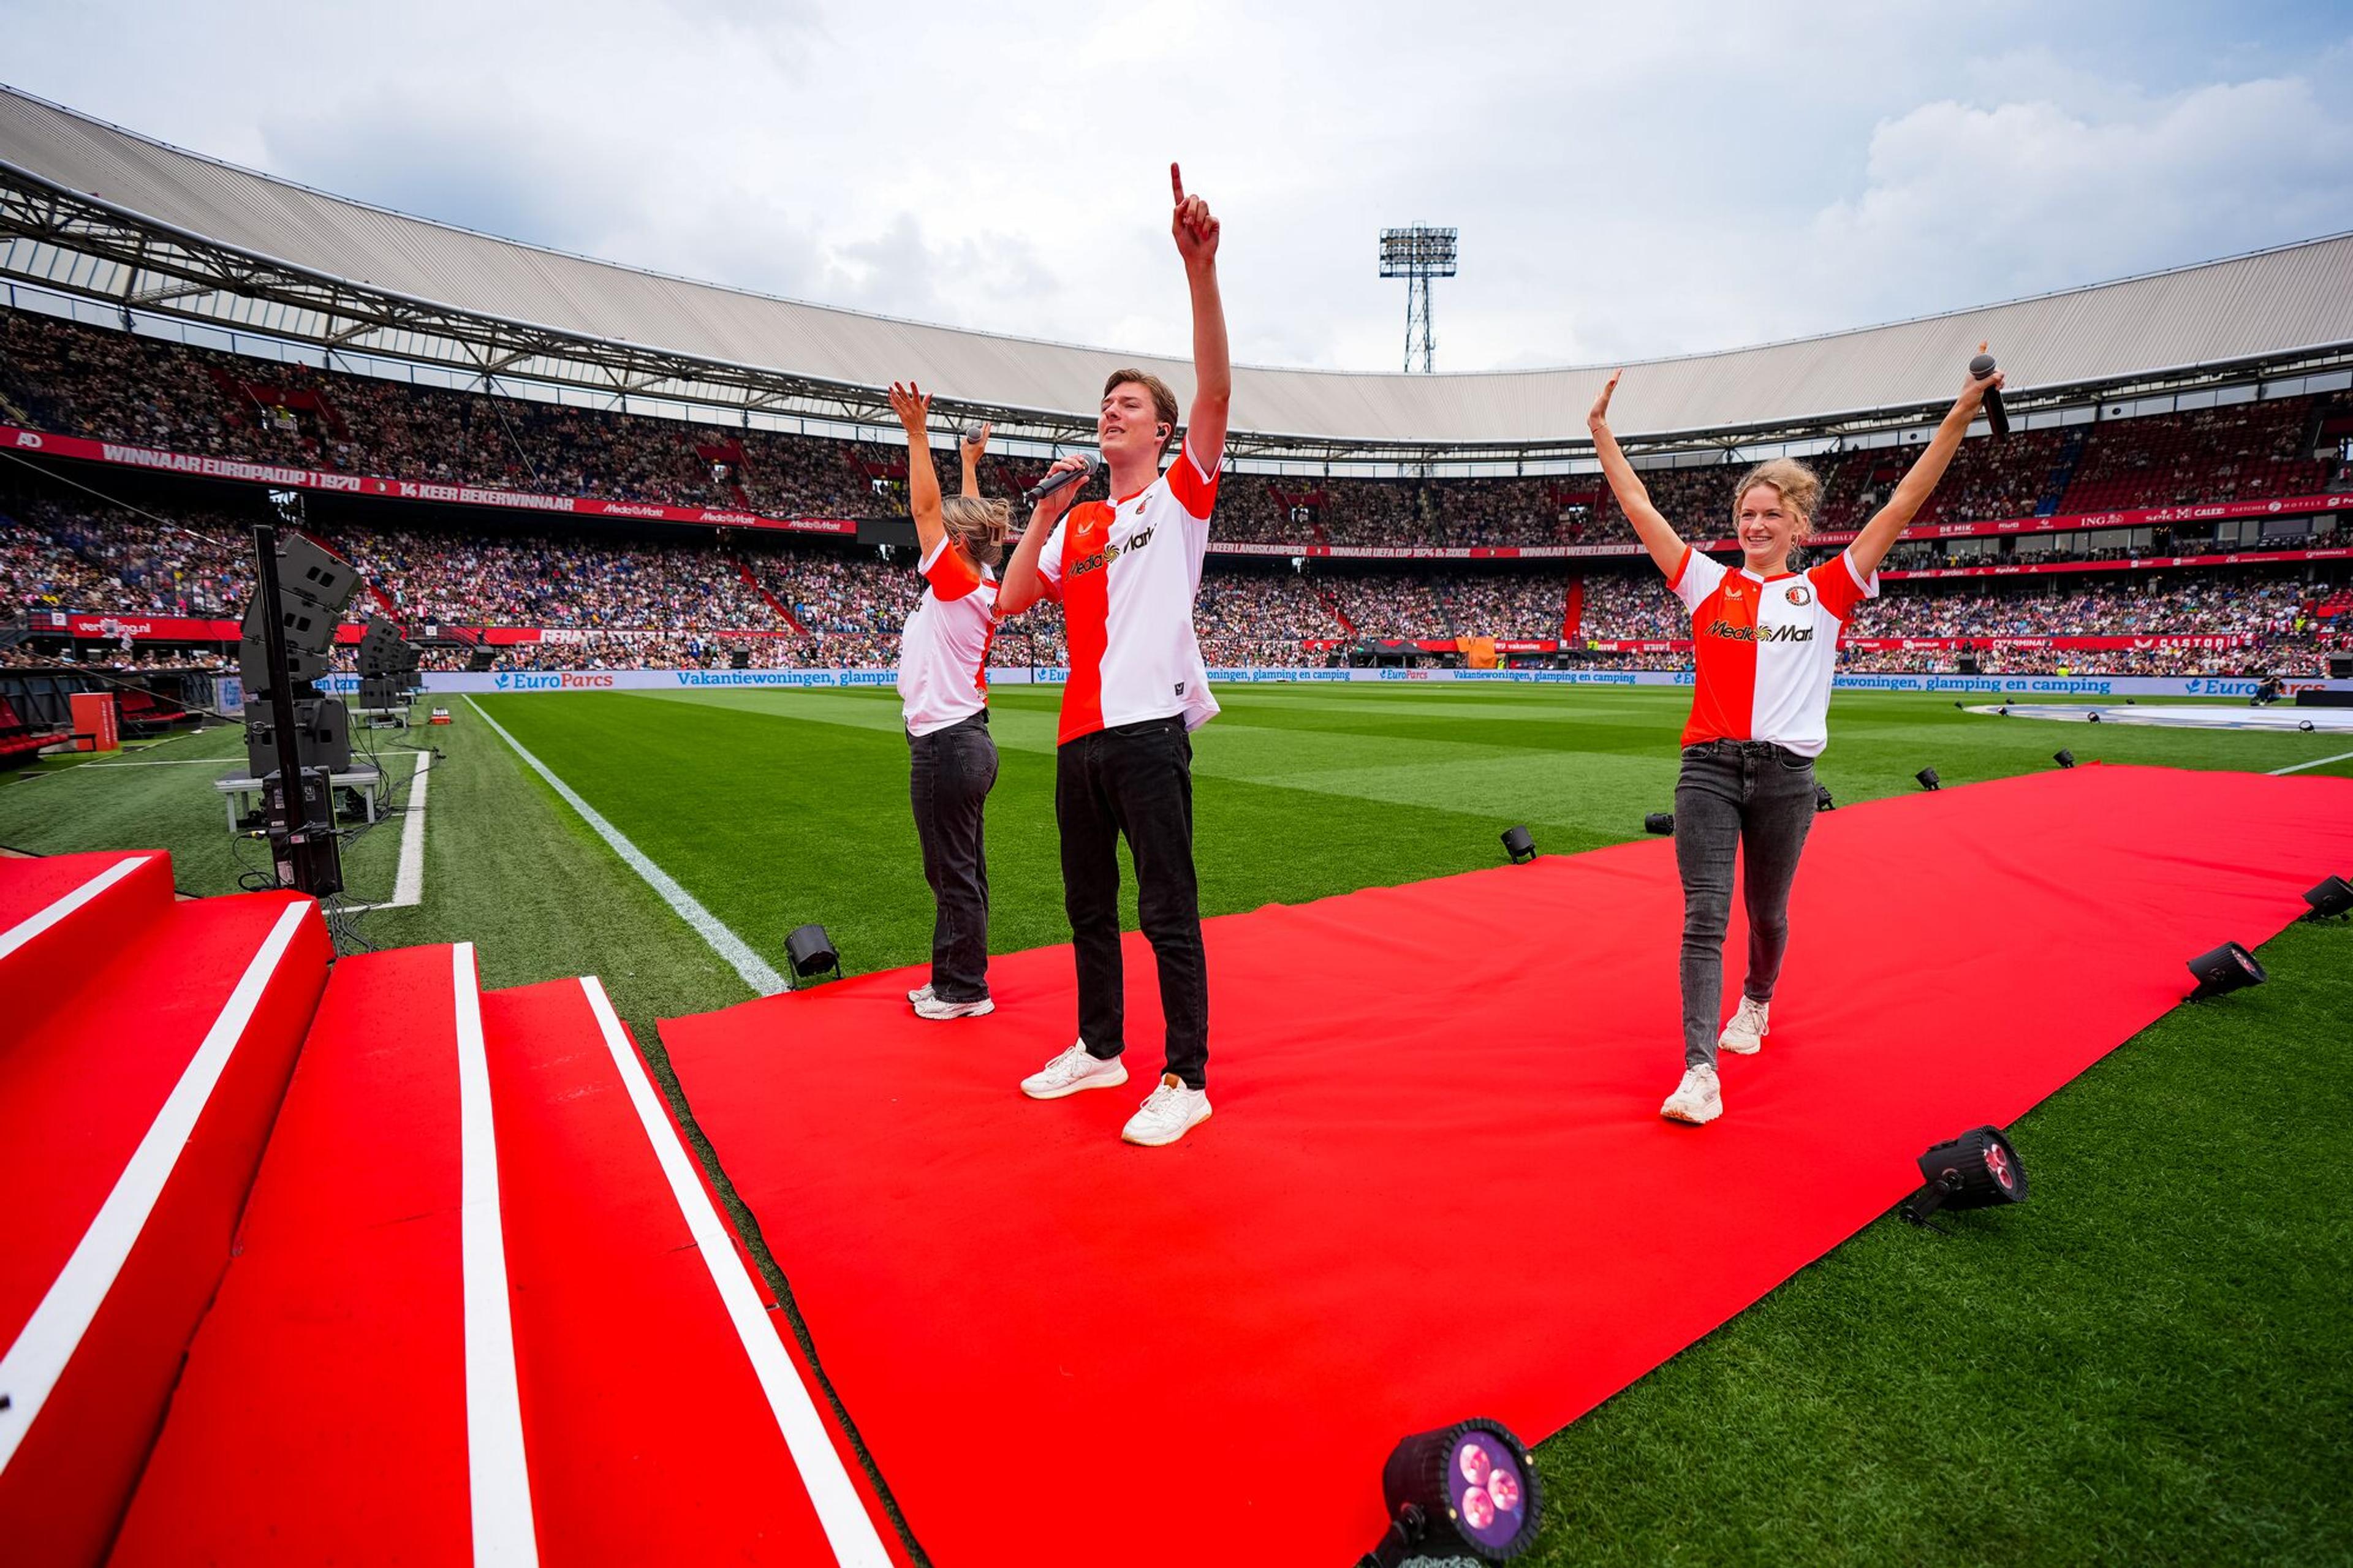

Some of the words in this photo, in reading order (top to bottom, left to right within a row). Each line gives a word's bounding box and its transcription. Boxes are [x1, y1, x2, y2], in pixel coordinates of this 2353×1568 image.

[17, 432, 42, 448] AD
[102, 443, 200, 471] WINNAAR
[203, 459, 306, 484] EUROPACUP
[308, 472, 316, 485] 1
[320, 474, 360, 491] 1970
[399, 482, 417, 498] 14
[419, 483, 458, 501] KEER
[459, 488, 574, 511] BEKERWINNAAR
[2081, 516, 2106, 526] ING
[1213, 543, 1234, 553] KEER
[1234, 543, 1306, 555] LANDSKAMPIOEN
[1330, 547, 1373, 557] WINNAAR
[1374, 547, 1394, 557] UEFA
[1395, 548, 1412, 557] CUP
[1446, 548, 1470, 557] 2002
[1520, 547, 1564, 557] WINNAAR
[1566, 545, 1634, 556] WERELDBEKER
[515, 673, 613, 689] EuroParcs
[677, 671, 835, 686] Vakantiewoningen,
[840, 670, 898, 686] glampin
[1253, 669, 1295, 681] glamping
[1313, 669, 1350, 681] camping
[1387, 669, 1428, 680] EuroParcs
[1453, 670, 1532, 681] Vakantiewoningen,
[1534, 671, 1576, 683] glamping
[1593, 673, 1635, 684] camping
[316, 678, 331, 691] en
[1926, 676, 2001, 692] glamping
[2006, 680, 2027, 690] en
[2032, 678, 2111, 694] camping
